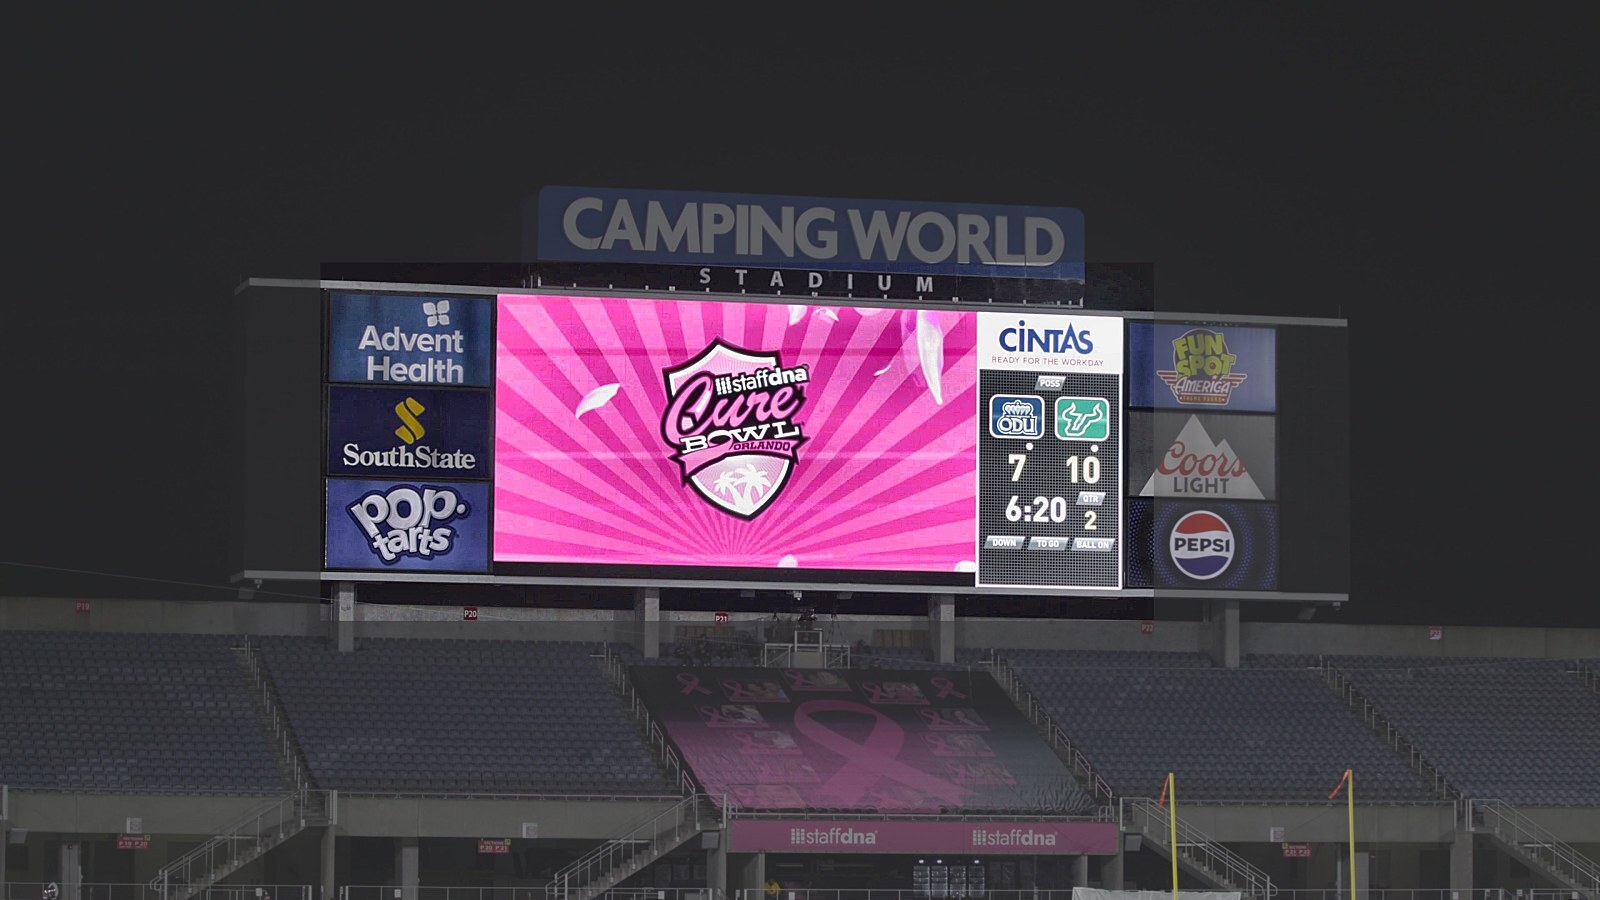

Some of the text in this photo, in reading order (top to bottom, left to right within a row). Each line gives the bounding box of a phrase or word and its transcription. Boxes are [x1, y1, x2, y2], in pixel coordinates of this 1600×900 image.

[563, 197, 1065, 267] CAMPING WORLD
[699, 267, 934, 293] STADIUM
[358, 325, 464, 353] Advent
[1174, 333, 1224, 361] FUN
[367, 355, 464, 383] Health
[991, 356, 1104, 367] READY FOR THE WORKDAY
[1176, 353, 1236, 378] SPOT
[732, 367, 808, 393] staffdna
[1040, 379, 1061, 388] POSS
[1173, 376, 1232, 395] AMERICA
[665, 375, 800, 444] Cure
[997, 416, 1037, 434] ODU
[679, 421, 800, 454] BOWL
[733, 441, 791, 452] ORLANDO
[343, 443, 476, 469] SouthState
[1157, 441, 1247, 477] Coors
[1008, 454, 1026, 482] 7
[1066, 455, 1100, 484] 10
[1173, 477, 1230, 494] LIGHT
[1005, 495, 1067, 523] 6:20
[1083, 495, 1099, 503] QTR
[1084, 510, 1097, 530] 2
[372, 526, 452, 561] tarts
[992, 539, 1017, 547] DOWN
[1037, 540, 1060, 548] TO GO
[1076, 540, 1109, 549] BALL ON
[1174, 538, 1230, 552] PEPSI
[76, 602, 90, 611] P19
[464, 609, 477, 618] P20
[806, 828, 876, 844] staffdna
[987, 829, 1056, 846] staffdna
